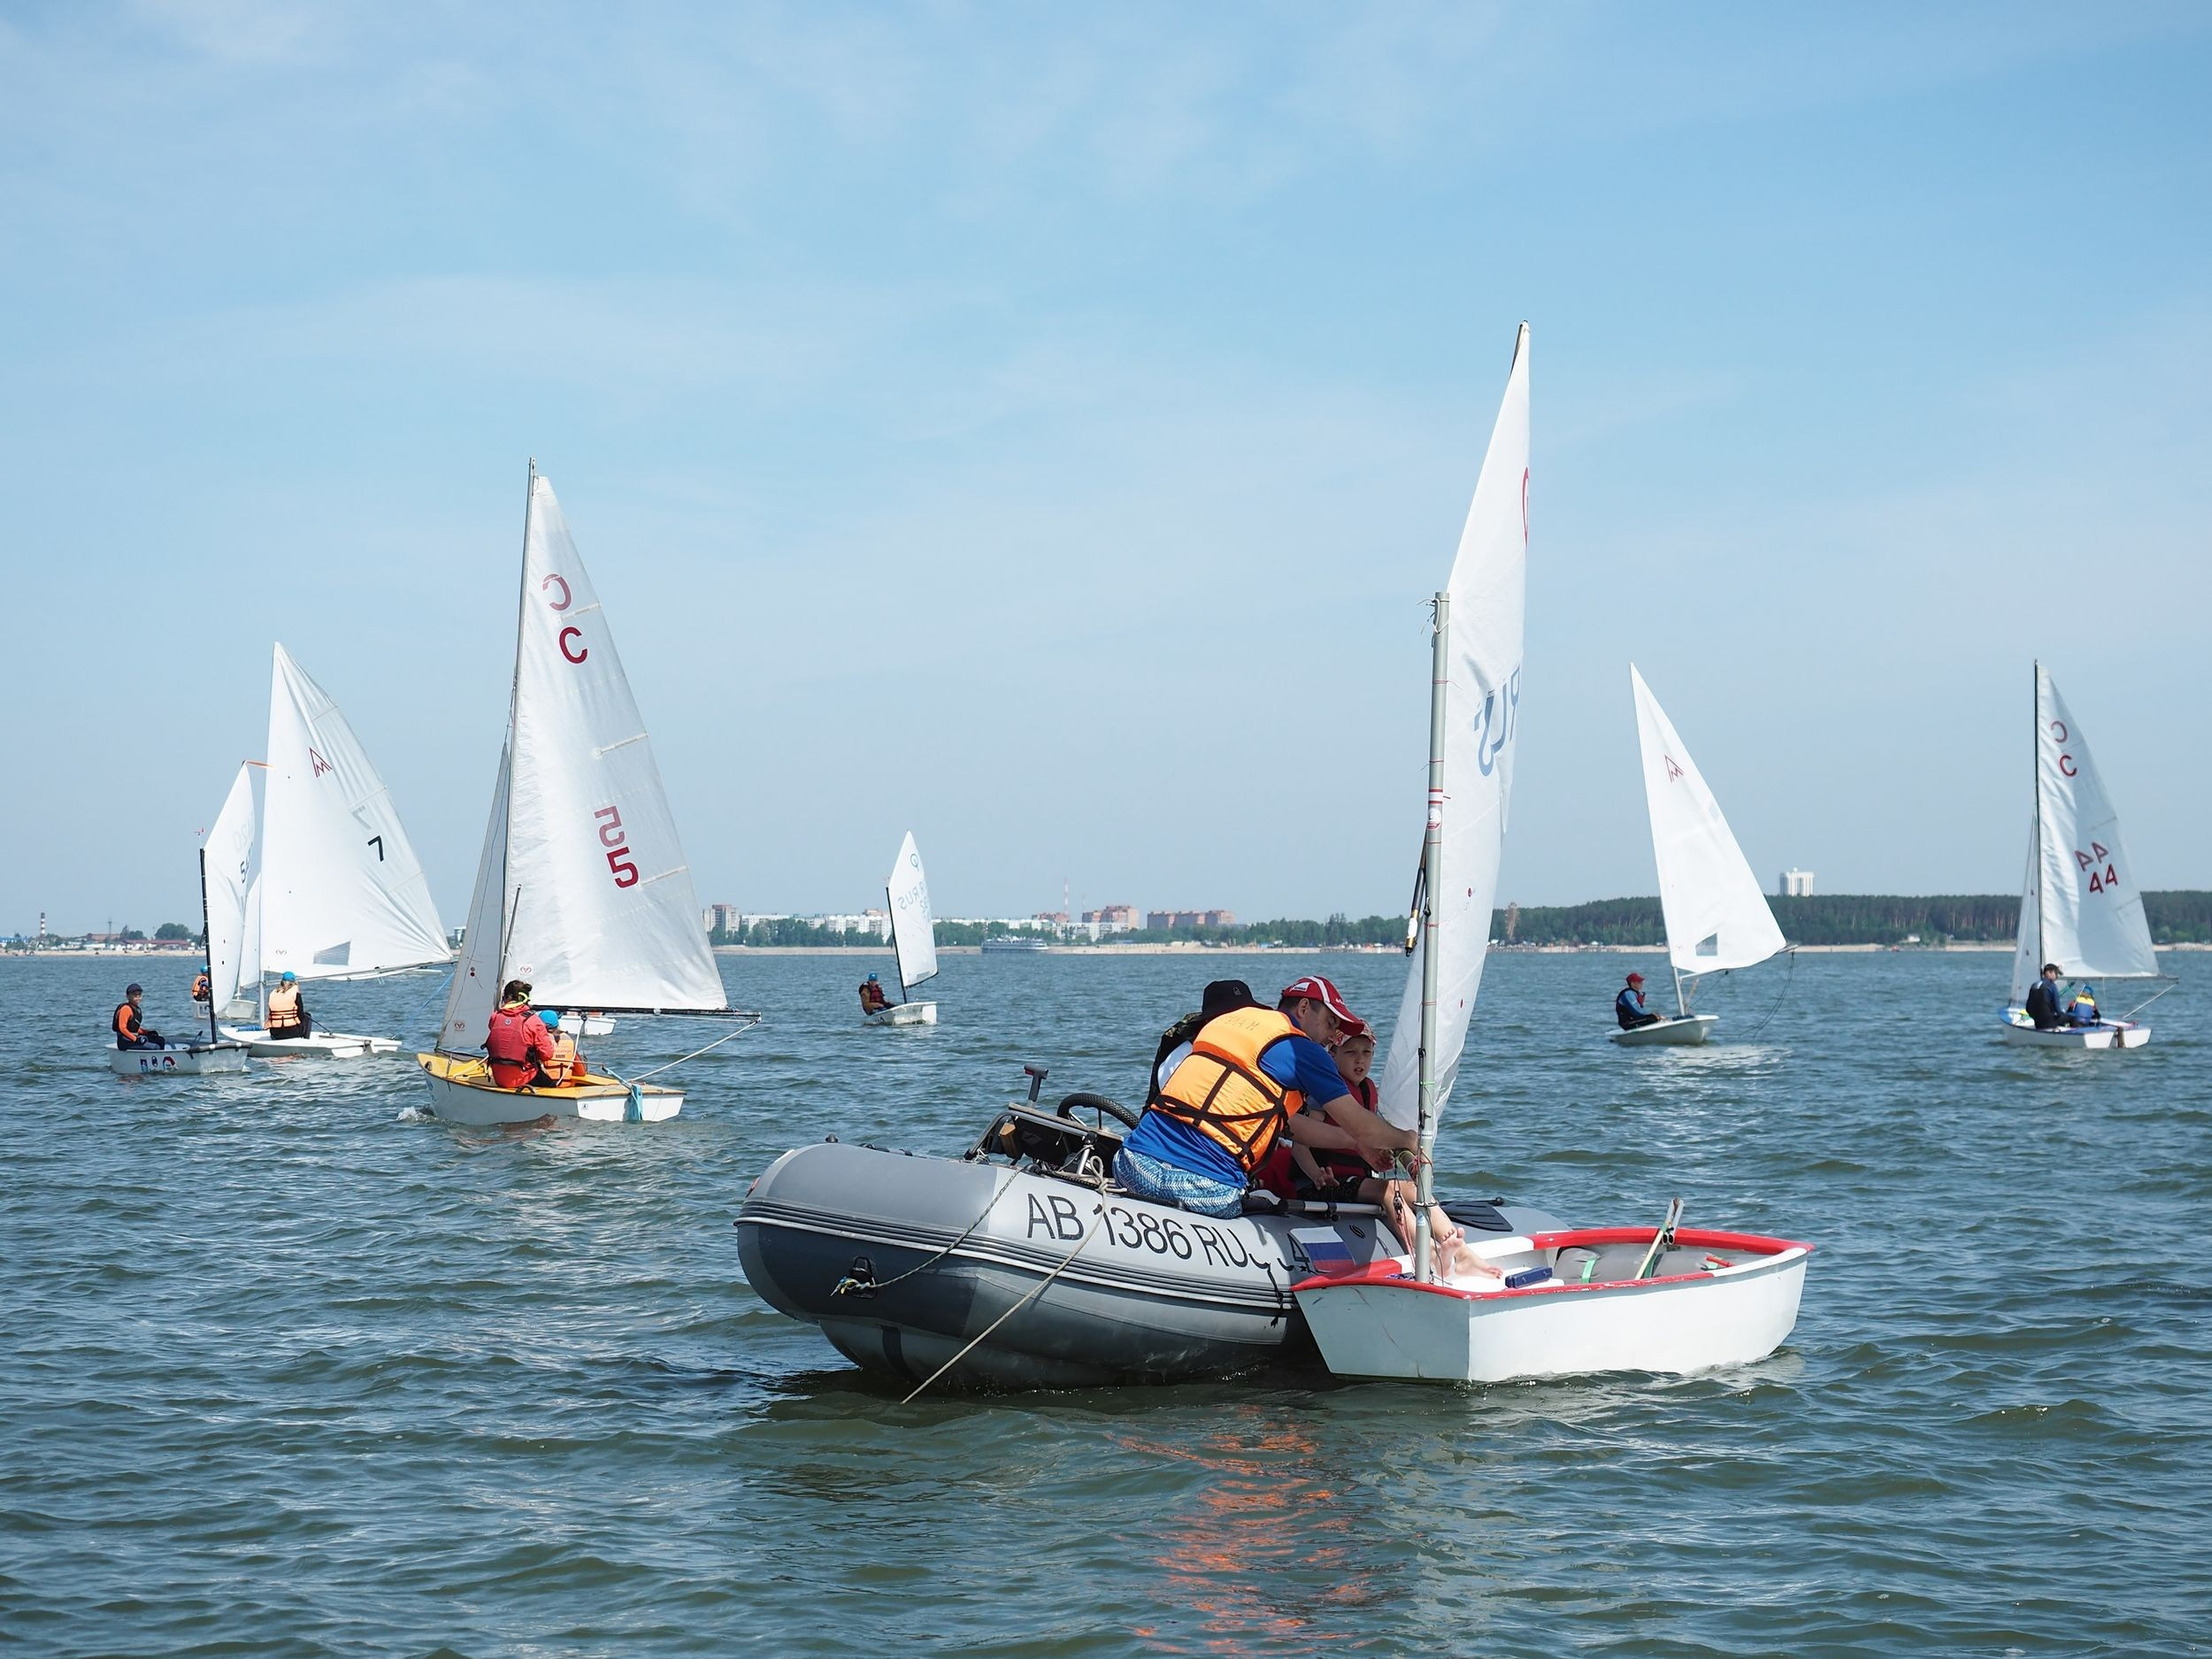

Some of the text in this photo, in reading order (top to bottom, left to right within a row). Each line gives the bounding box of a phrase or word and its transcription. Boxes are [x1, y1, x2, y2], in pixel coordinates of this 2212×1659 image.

[558, 626, 588, 664] C
[2059, 755, 2078, 777] C
[367, 835, 384, 862] 7
[606, 846, 639, 888] 5
[2089, 864, 2118, 894] 44
[1027, 1194, 1084, 1240] AB
[1093, 1203, 1192, 1260] 1386
